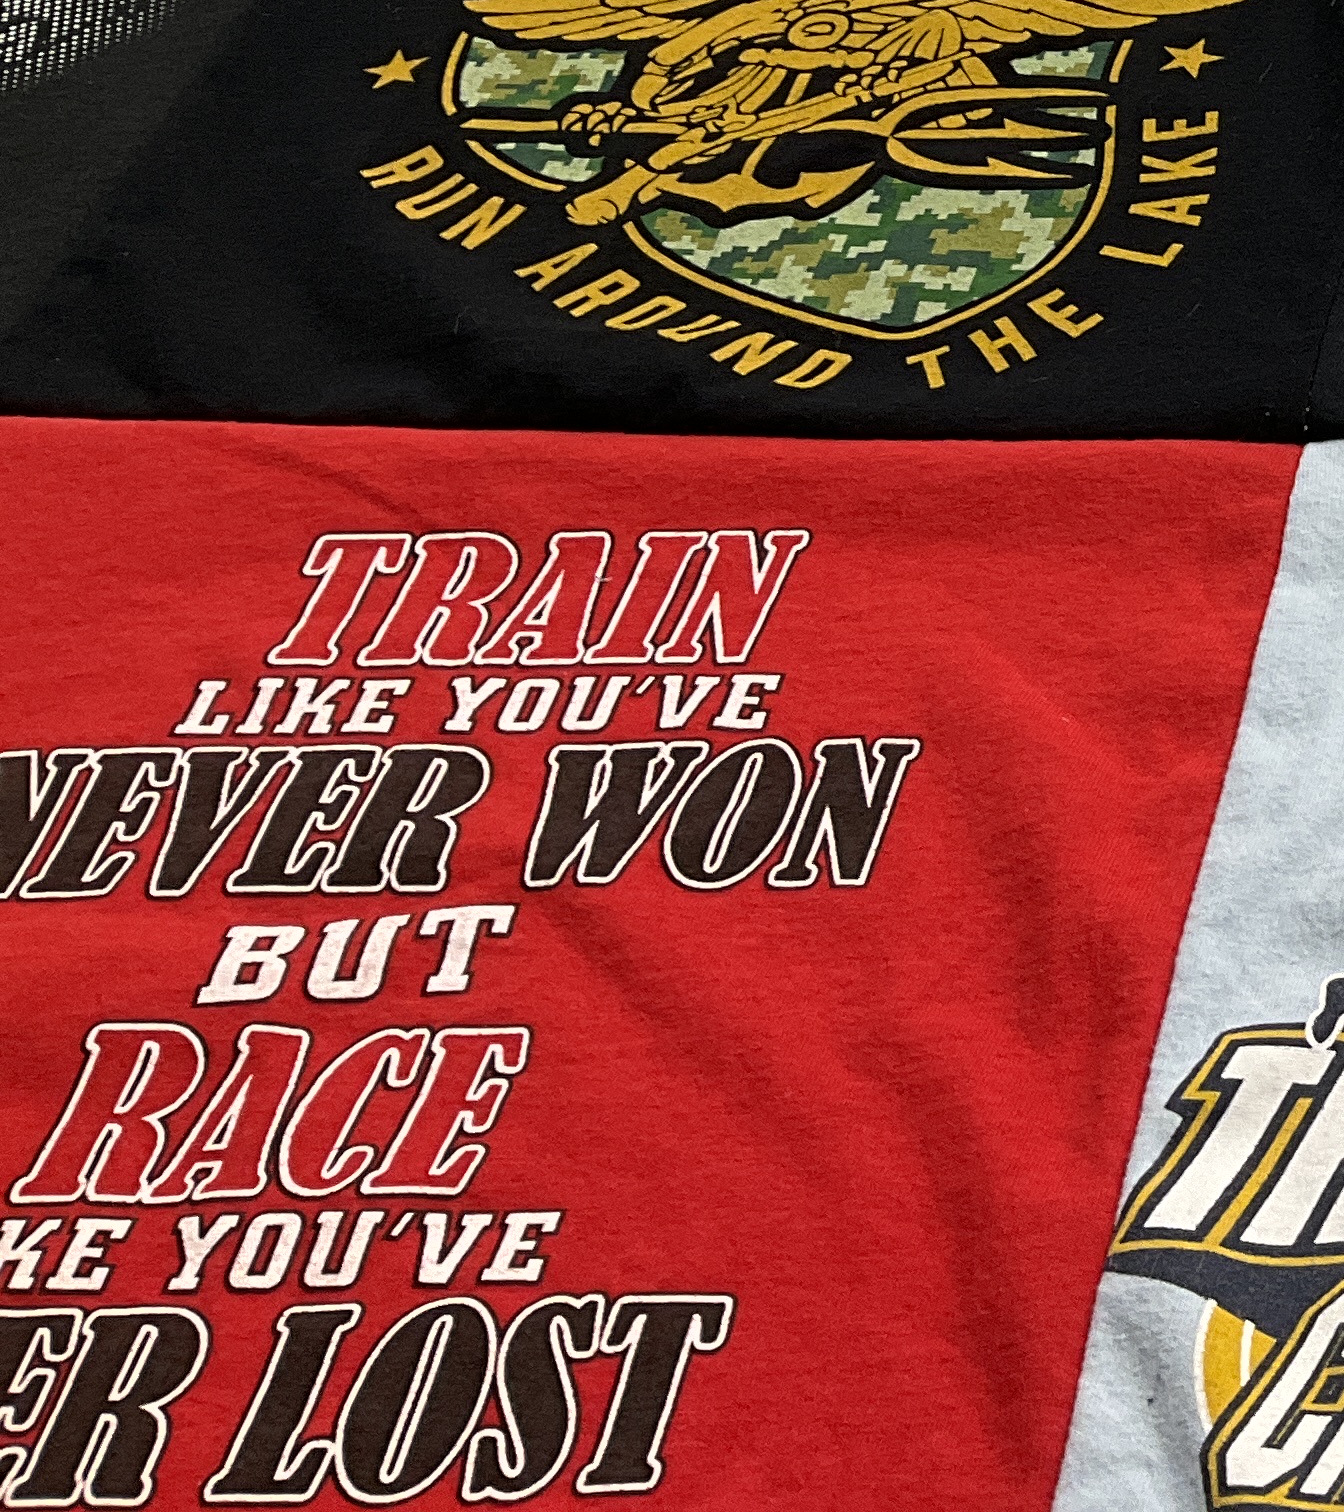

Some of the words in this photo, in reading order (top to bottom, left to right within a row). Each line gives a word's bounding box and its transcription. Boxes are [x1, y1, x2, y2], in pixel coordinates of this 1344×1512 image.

[360, 144, 527, 251] RUN
[513, 242, 855, 390] AROUND
[905, 287, 1106, 390] THE
[1098, 110, 1219, 269] LAKE
[267, 530, 810, 669] TRAIN
[172, 679, 408, 737] LIKE
[443, 674, 781, 733] YOU'VE
[521, 739, 922, 889] WON
[196, 904, 517, 1006] BUT
[8, 1022, 530, 1205] RACE
[168, 1210, 564, 1291] YOU'VE
[203, 1295, 735, 1504] LOST
